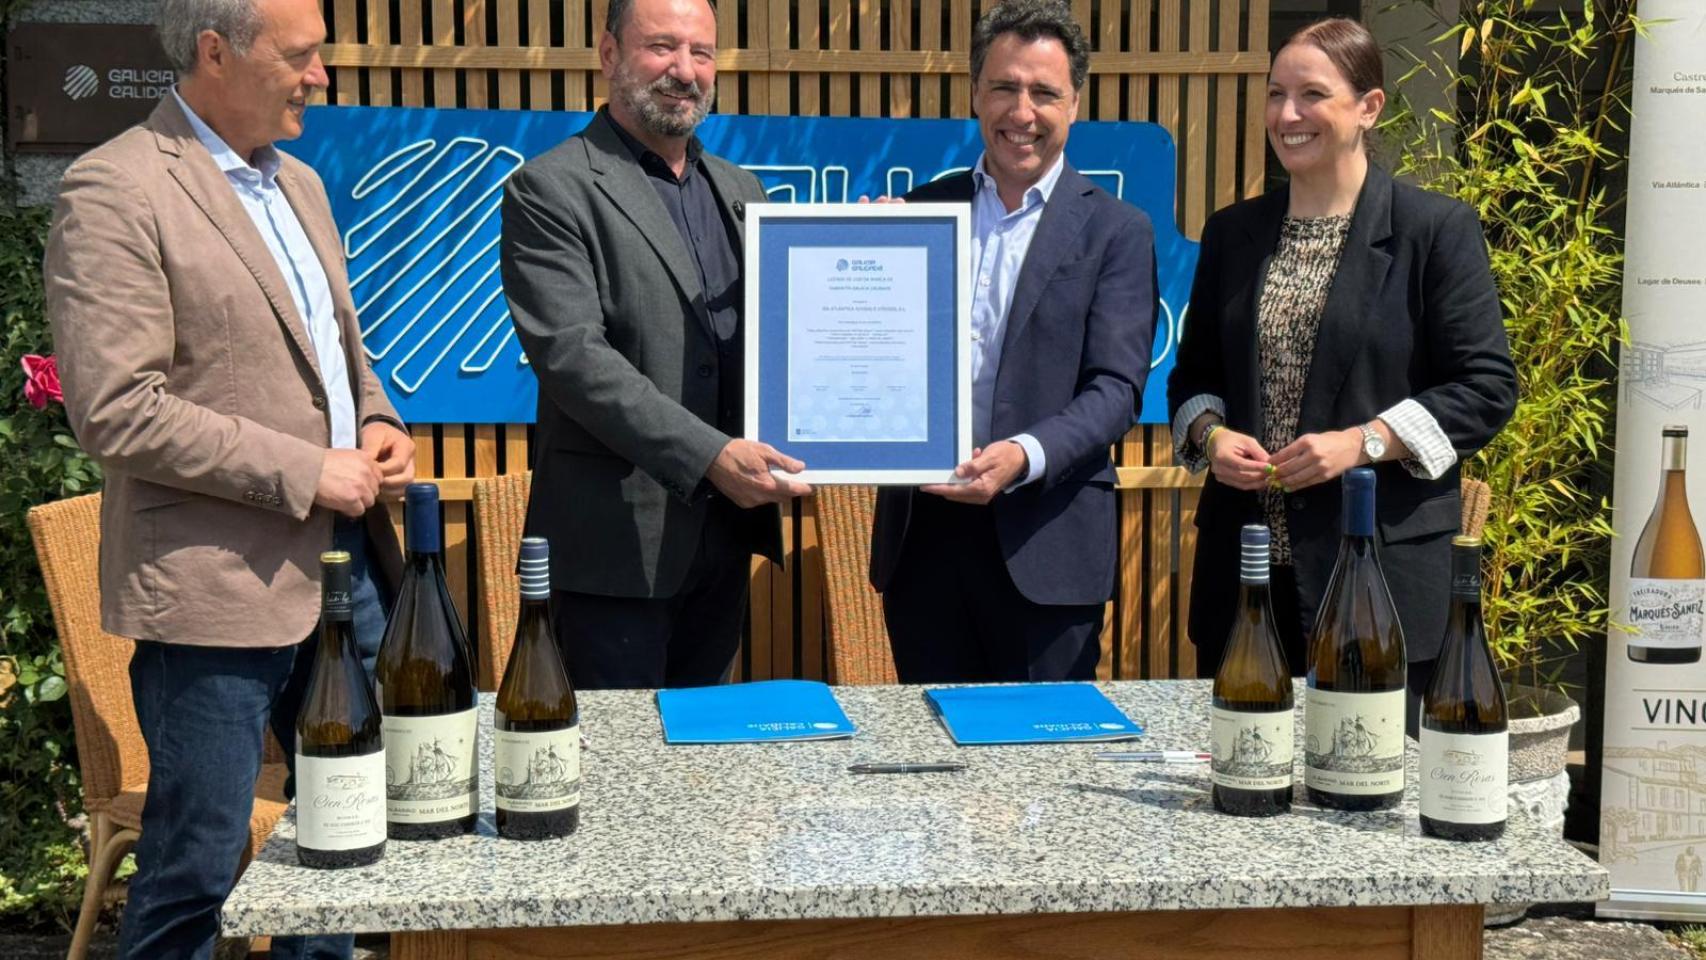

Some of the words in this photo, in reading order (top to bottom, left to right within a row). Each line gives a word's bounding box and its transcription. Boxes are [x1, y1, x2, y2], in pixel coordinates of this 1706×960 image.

[108, 69, 174, 83] GALICIA
[109, 86, 171, 99] CALIDA
[1643, 698, 1706, 724] VIN
